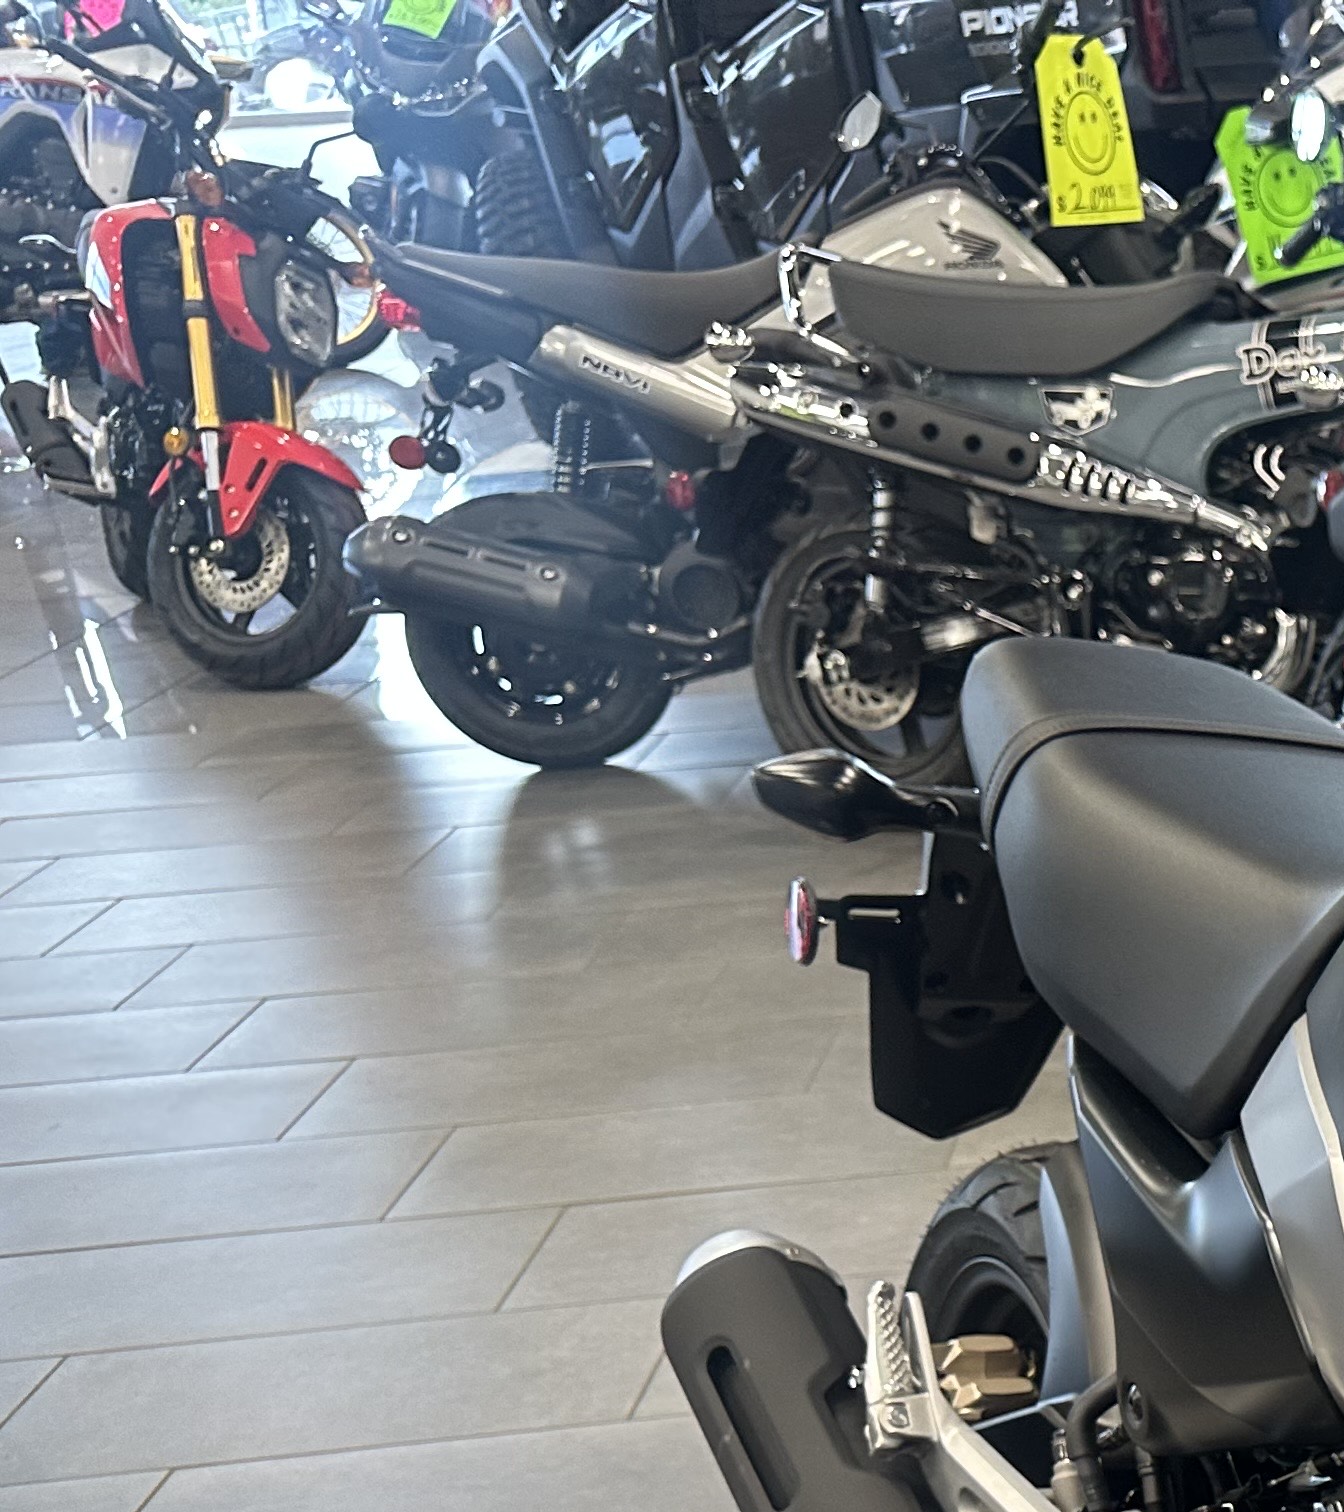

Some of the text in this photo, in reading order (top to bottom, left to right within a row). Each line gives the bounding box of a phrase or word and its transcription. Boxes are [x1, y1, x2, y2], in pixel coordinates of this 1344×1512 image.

[1052, 94, 1066, 147] HAVE
[1076, 71, 1104, 92] NICE
[577, 355, 651, 395] NAVI
